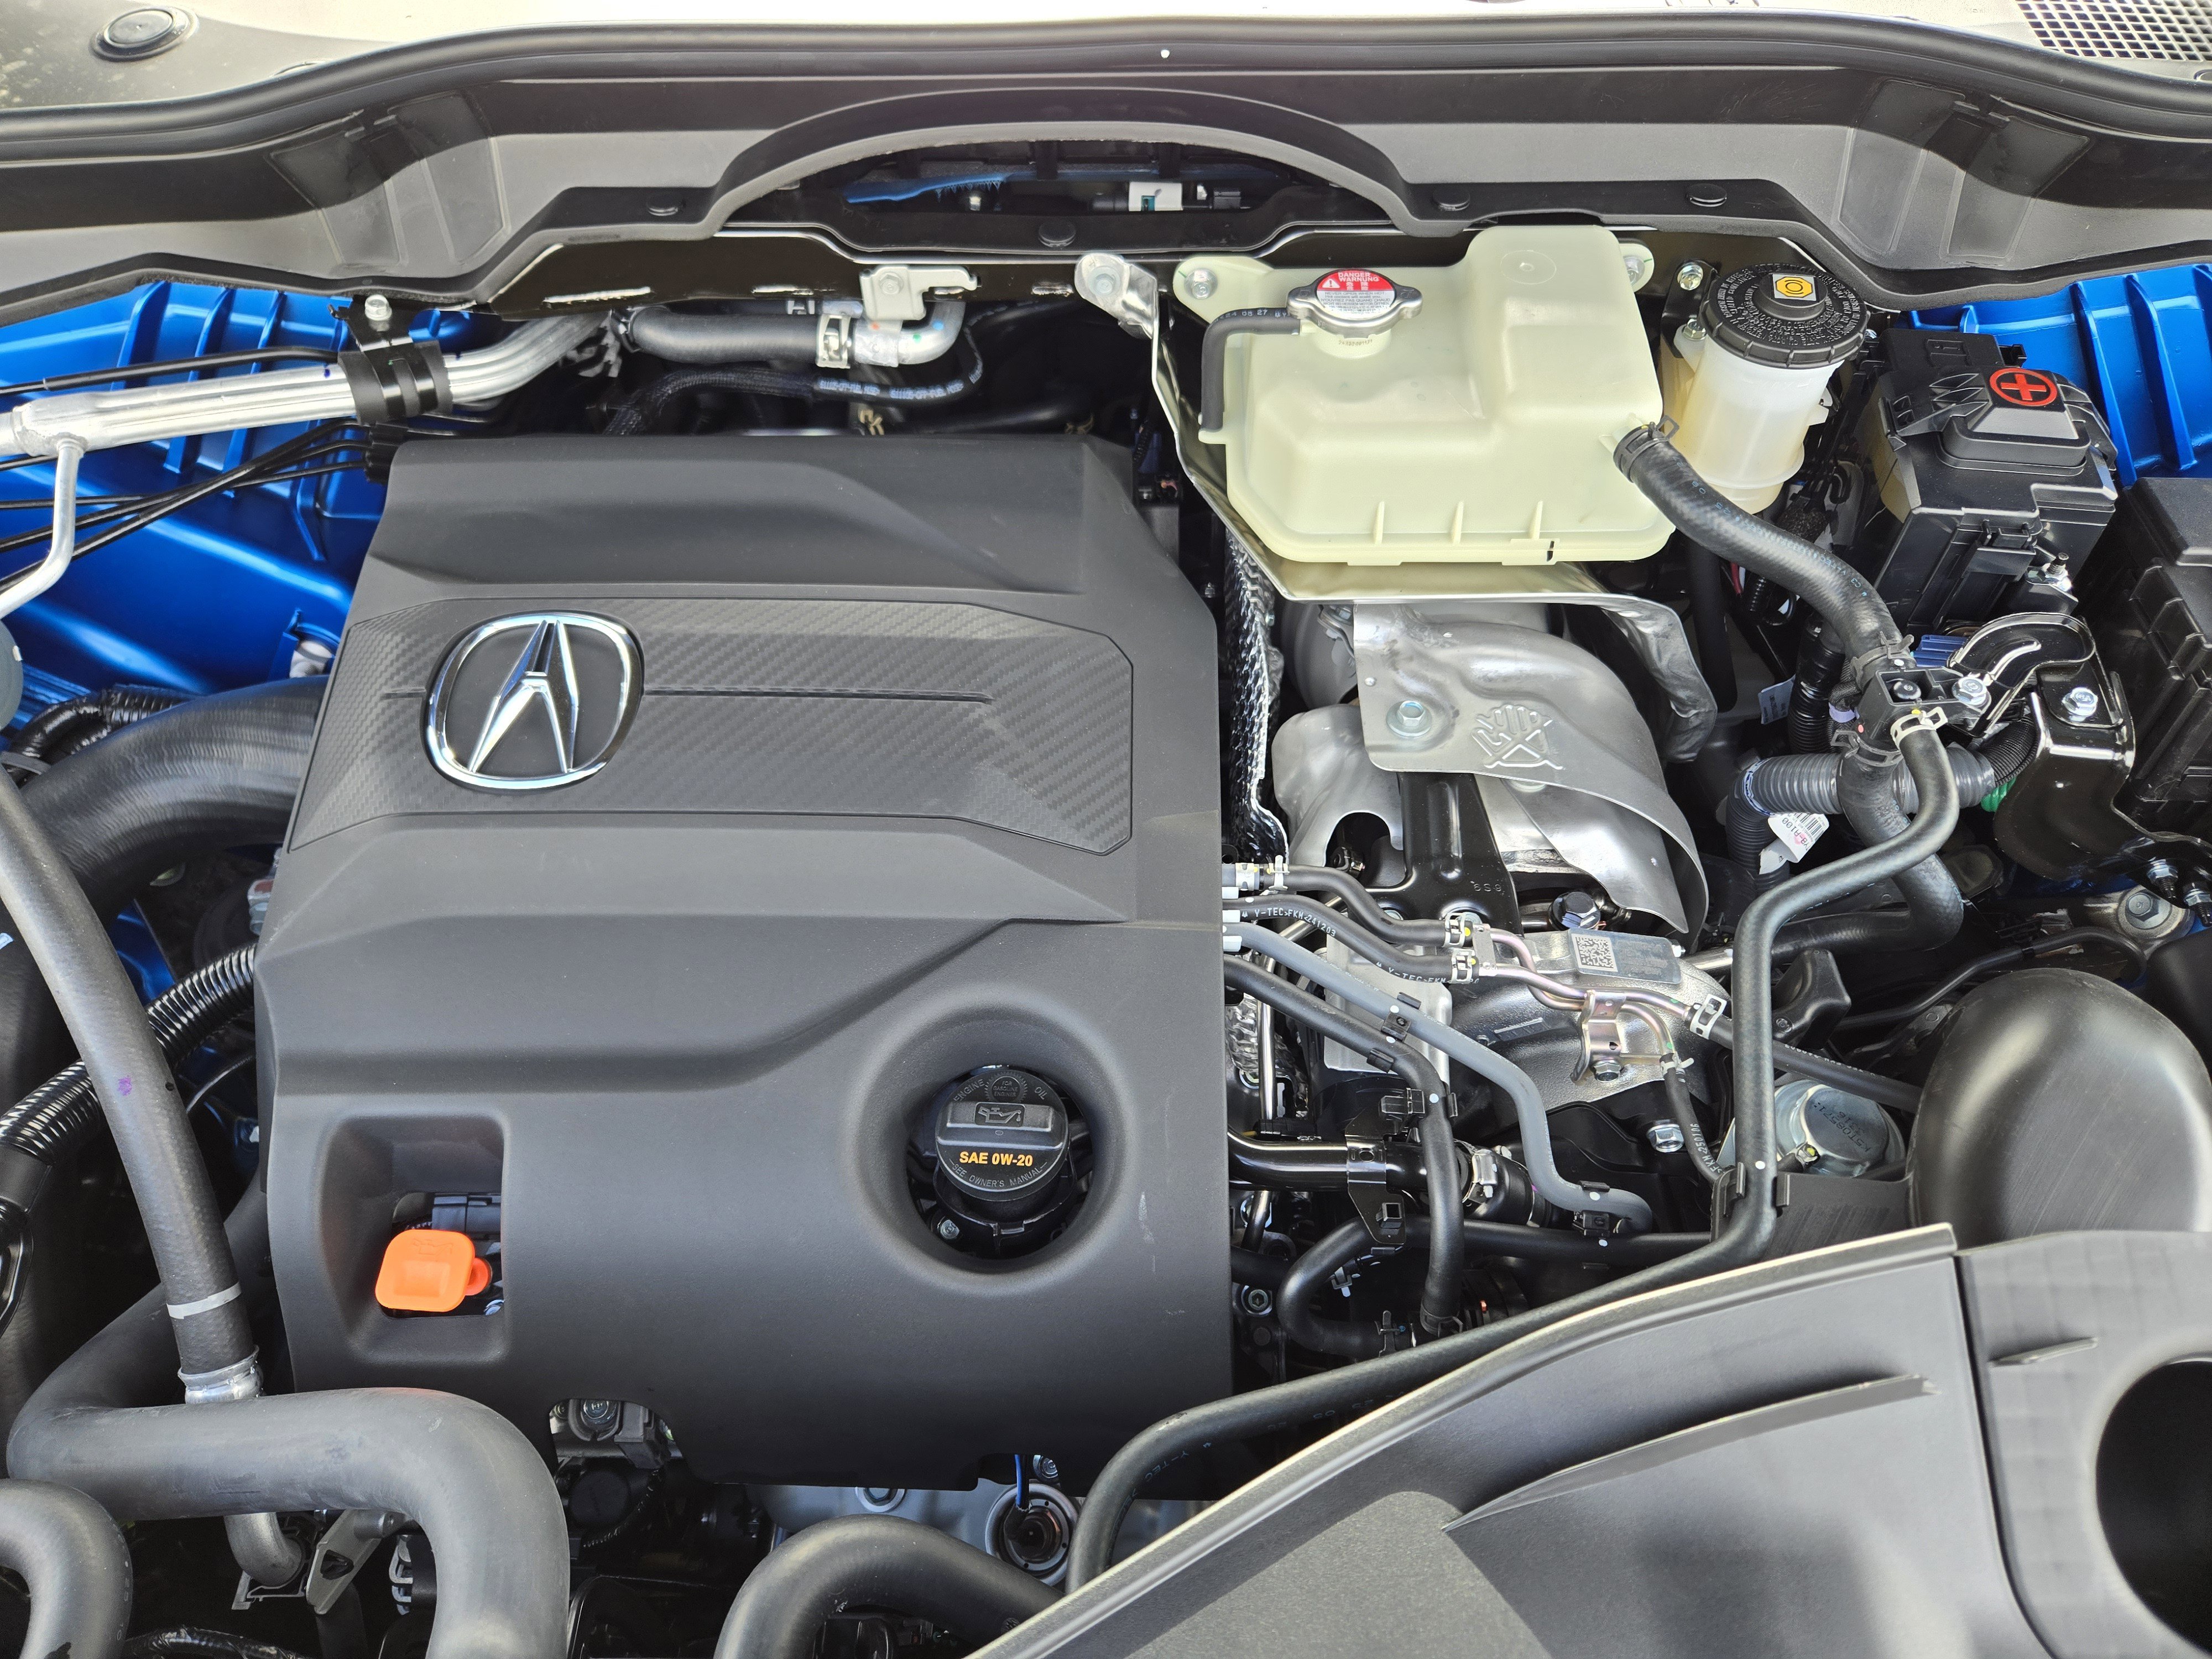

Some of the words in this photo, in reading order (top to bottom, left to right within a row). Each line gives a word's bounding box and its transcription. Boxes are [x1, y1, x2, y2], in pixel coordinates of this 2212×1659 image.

[953, 1079, 985, 1102] ENGINE
[1034, 1087, 1047, 1100] OIL
[959, 1151, 988, 1164] SAE
[992, 1153, 1033, 1167] 0W-20
[952, 1164, 967, 1177] SEE
[969, 1175, 1005, 1187] OWNER'S
[1009, 1167, 1042, 1186] MANUAL
